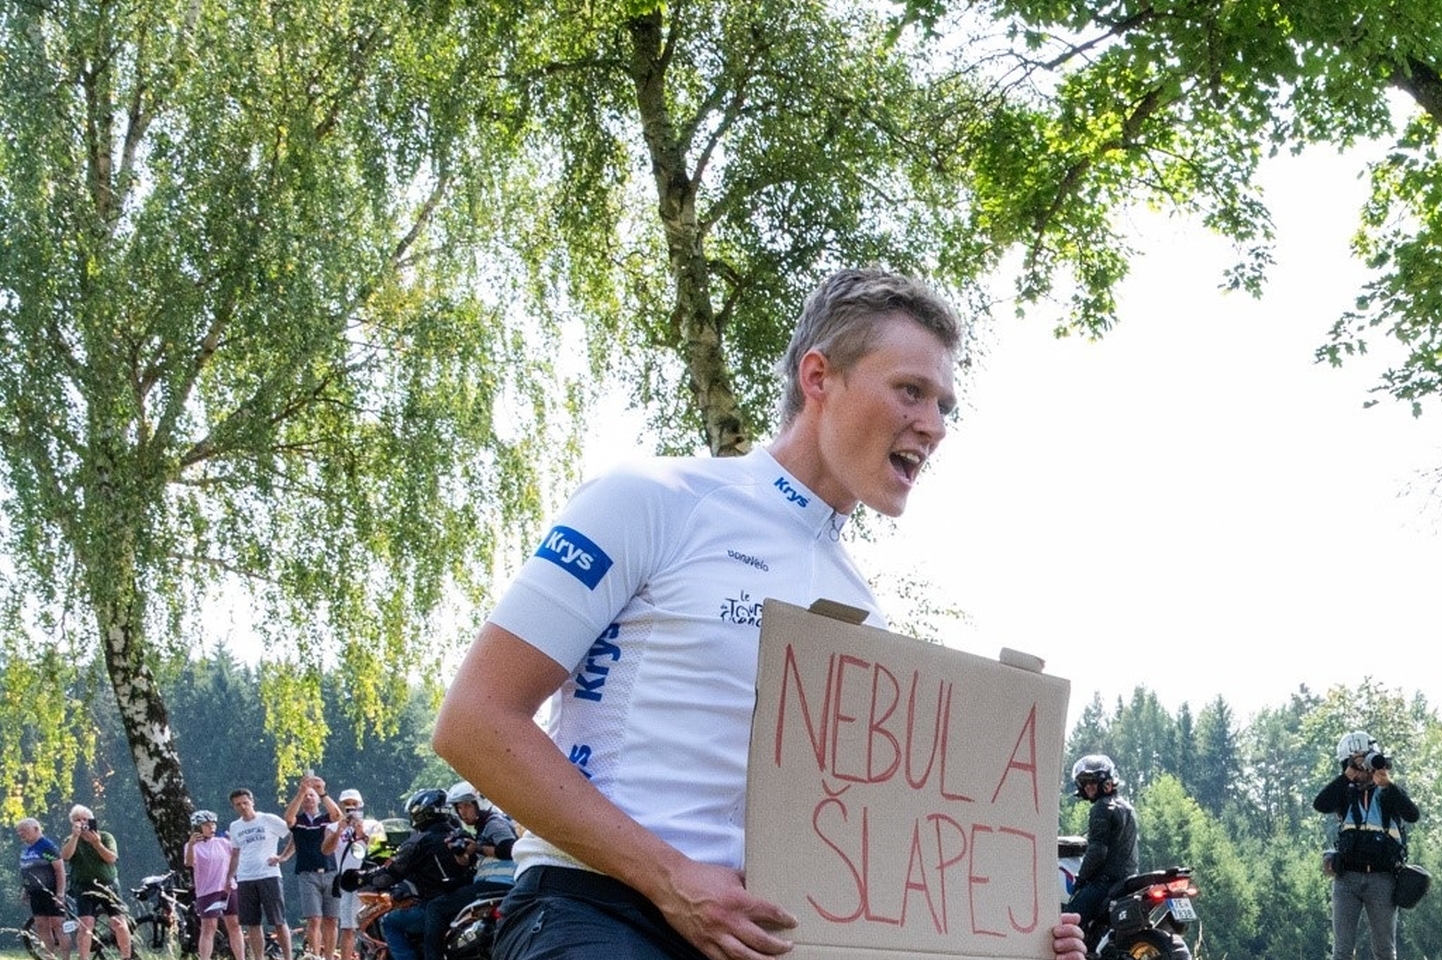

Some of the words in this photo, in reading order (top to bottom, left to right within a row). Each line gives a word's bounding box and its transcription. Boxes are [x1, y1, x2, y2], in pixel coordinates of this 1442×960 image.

[773, 476, 810, 508] Krys
[545, 530, 595, 571] Krys
[774, 643, 975, 802] NEBUL
[990, 700, 1039, 815] A
[806, 777, 1039, 938] ŠLAPEJ
